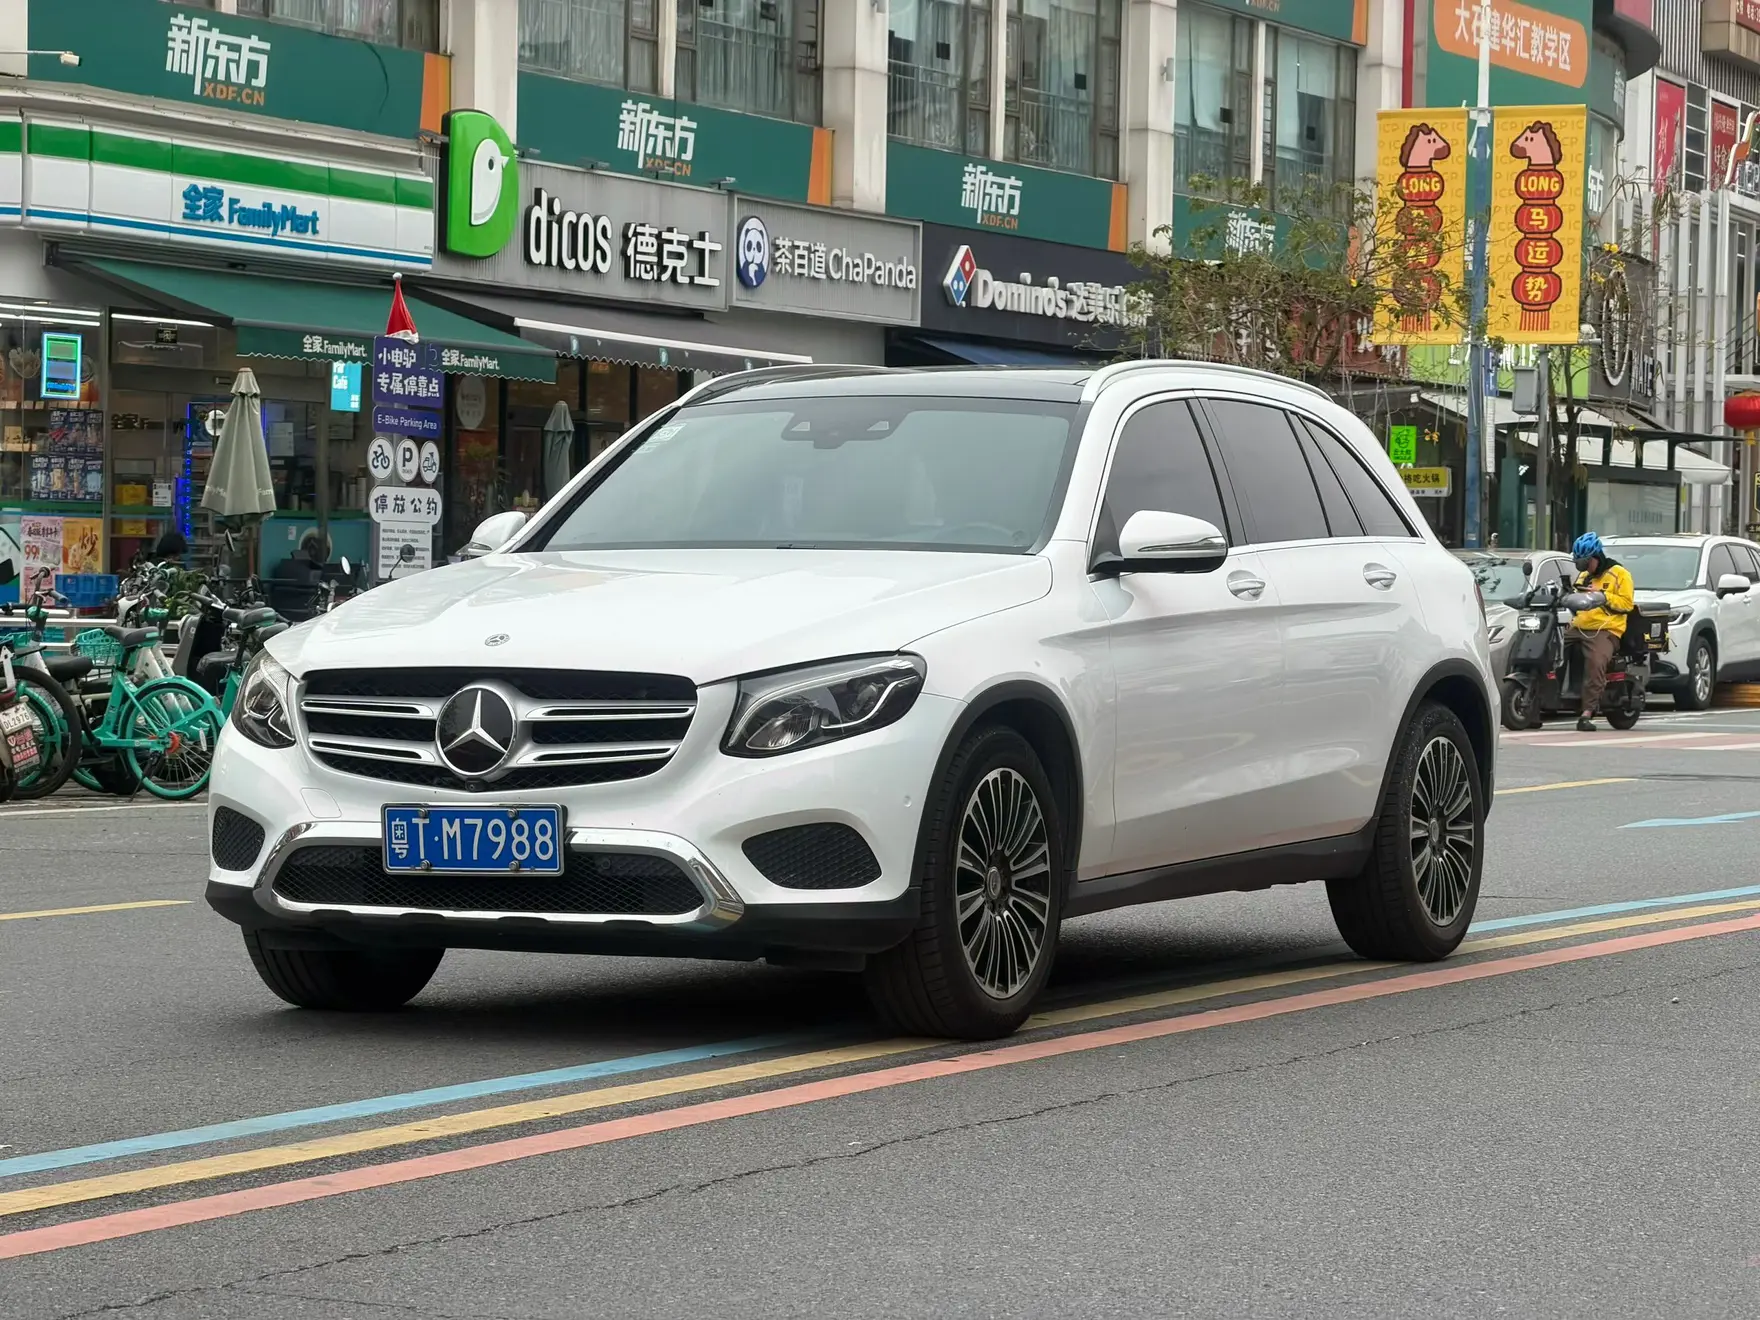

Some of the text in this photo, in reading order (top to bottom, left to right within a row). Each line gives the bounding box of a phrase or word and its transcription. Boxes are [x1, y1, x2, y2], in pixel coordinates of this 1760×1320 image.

[166, 13, 271, 95] 新东方
[203, 82, 265, 106] XDF.CN
[617, 99, 697, 168] 新东方
[961, 163, 1023, 224] 新东方
[1402, 177, 1441, 193] LONG
[1520, 175, 1560, 192] LONG
[183, 184, 320, 237] 全家 FamilyMart
[982, 214, 1018, 230] XDF.CN
[525, 188, 612, 274] dicos
[624, 222, 722, 287] 德克士
[774, 237, 916, 289] 茶百道 ChaPanda
[971, 268, 1067, 319] Domino's
[303, 335, 323, 353] 全家
[378, 347, 417, 368] 小电驴
[441, 349, 459, 366] 全家
[377, 372, 440, 397] 专属停靠点
[377, 414, 437, 430] E-Bike Parking Area
[374, 493, 438, 515] 停放公约
[391, 817, 554, 860] 粤T·M7988
